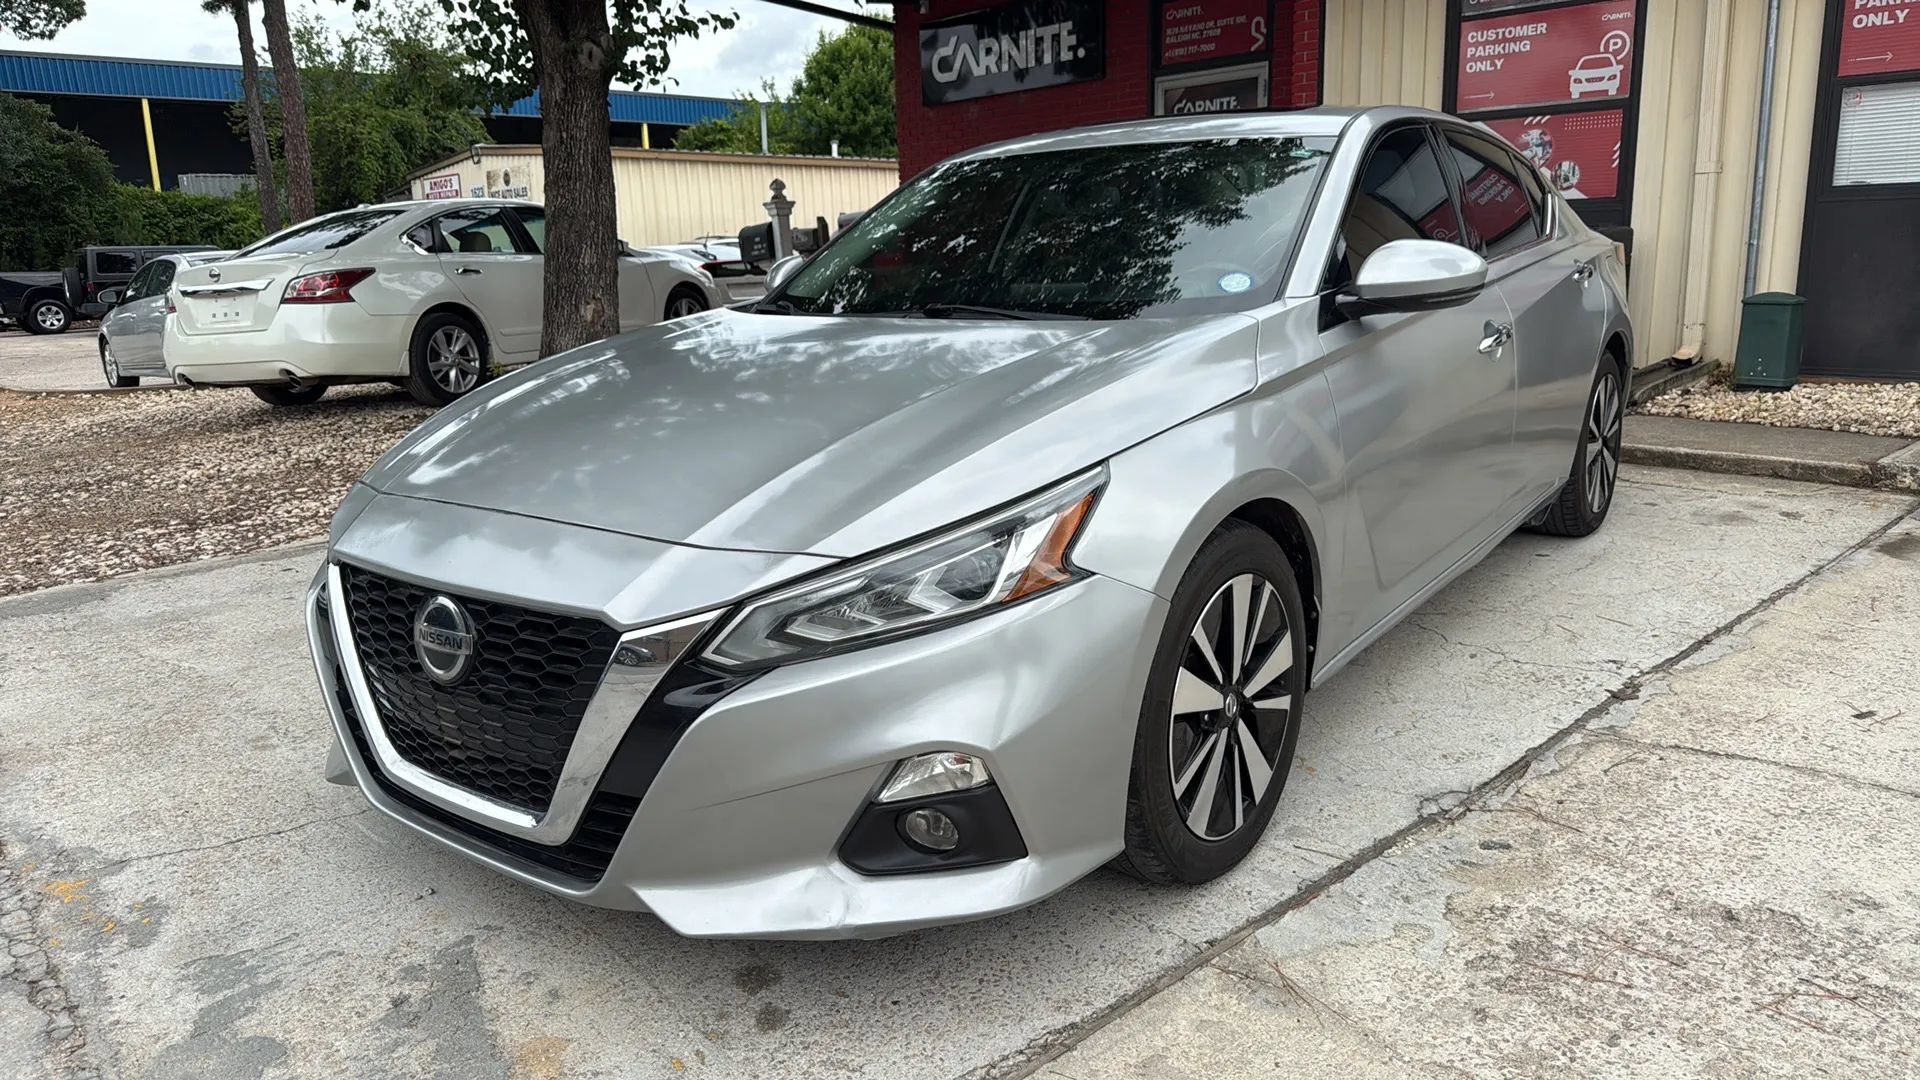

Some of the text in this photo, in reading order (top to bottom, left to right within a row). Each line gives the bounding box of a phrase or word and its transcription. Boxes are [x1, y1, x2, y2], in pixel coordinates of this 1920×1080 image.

[1853, 8, 1910, 28] ONLY
[1468, 22, 1547, 43] CUSTOMER
[932, 20, 1086, 83] CARNITE.
[1467, 40, 1531, 58] PARKING
[1466, 58, 1504, 73] ONLY
[514, 186, 528, 199] SALES
[419, 629, 463, 650] NISSAN
